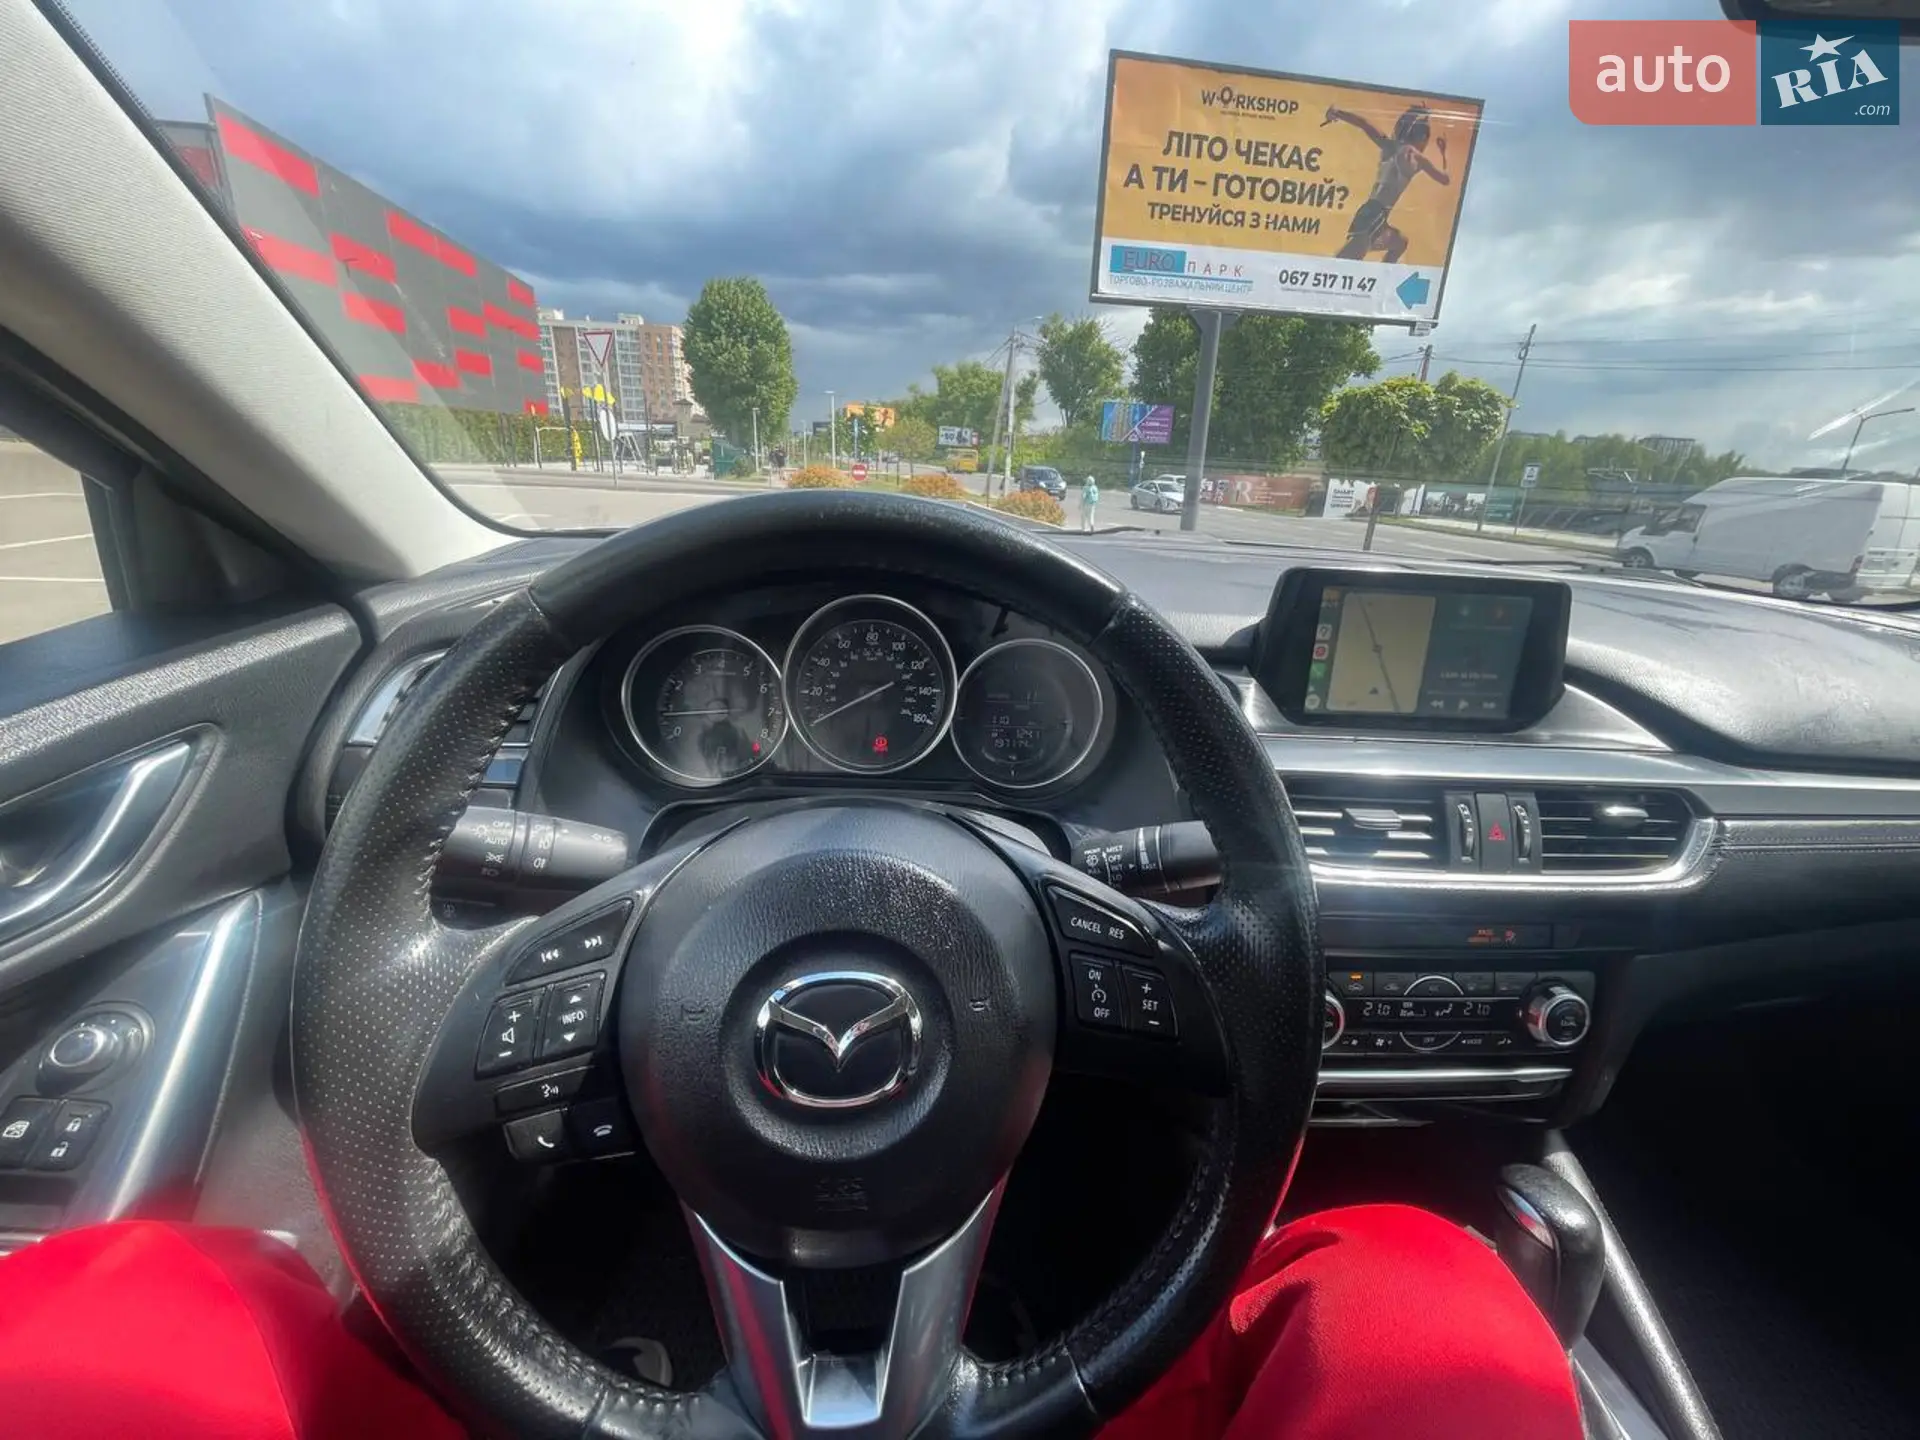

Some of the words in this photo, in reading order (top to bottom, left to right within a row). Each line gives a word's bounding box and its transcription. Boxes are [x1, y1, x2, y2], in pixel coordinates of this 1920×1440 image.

[1201, 86, 1299, 115] WORKSHOP
[1162, 130, 1228, 162] ЛІТО
[1235, 138, 1323, 172] ЧЕКАЄ
[1123, 163, 1145, 189] А
[1151, 166, 1188, 193] ТИ
[1212, 172, 1349, 210] ГОТОВИЙ?
[1147, 202, 1246, 228] ТРЕНУЙСЯ
[1264, 213, 1321, 235] НАМИ
[1122, 250, 1176, 271] EURO
[1187, 260, 1244, 277] ПАРК
[1279, 269, 1309, 286] 067
[1312, 272, 1338, 289] 517
[1341, 275, 1354, 290] 11
[1357, 277, 1377, 292] 47
[865, 632, 879, 641] 80
[838, 640, 850, 649] 60
[892, 641, 906, 651] 100
[817, 657, 831, 667] 40
[911, 660, 926, 670] 120
[760, 683, 768, 693] 6
[810, 686, 823, 696] 20
[918, 686, 932, 695] 140
[913, 713, 927, 723] 160
[1108, 854, 1121, 863] OFF
[1070, 916, 1102, 935] CANCEL
[1108, 926, 1125, 941] RES
[1088, 969, 1102, 981] ON
[1142, 999, 1159, 1011] SET
[562, 1010, 585, 1024] INFO
[1094, 1007, 1111, 1019] OFF
